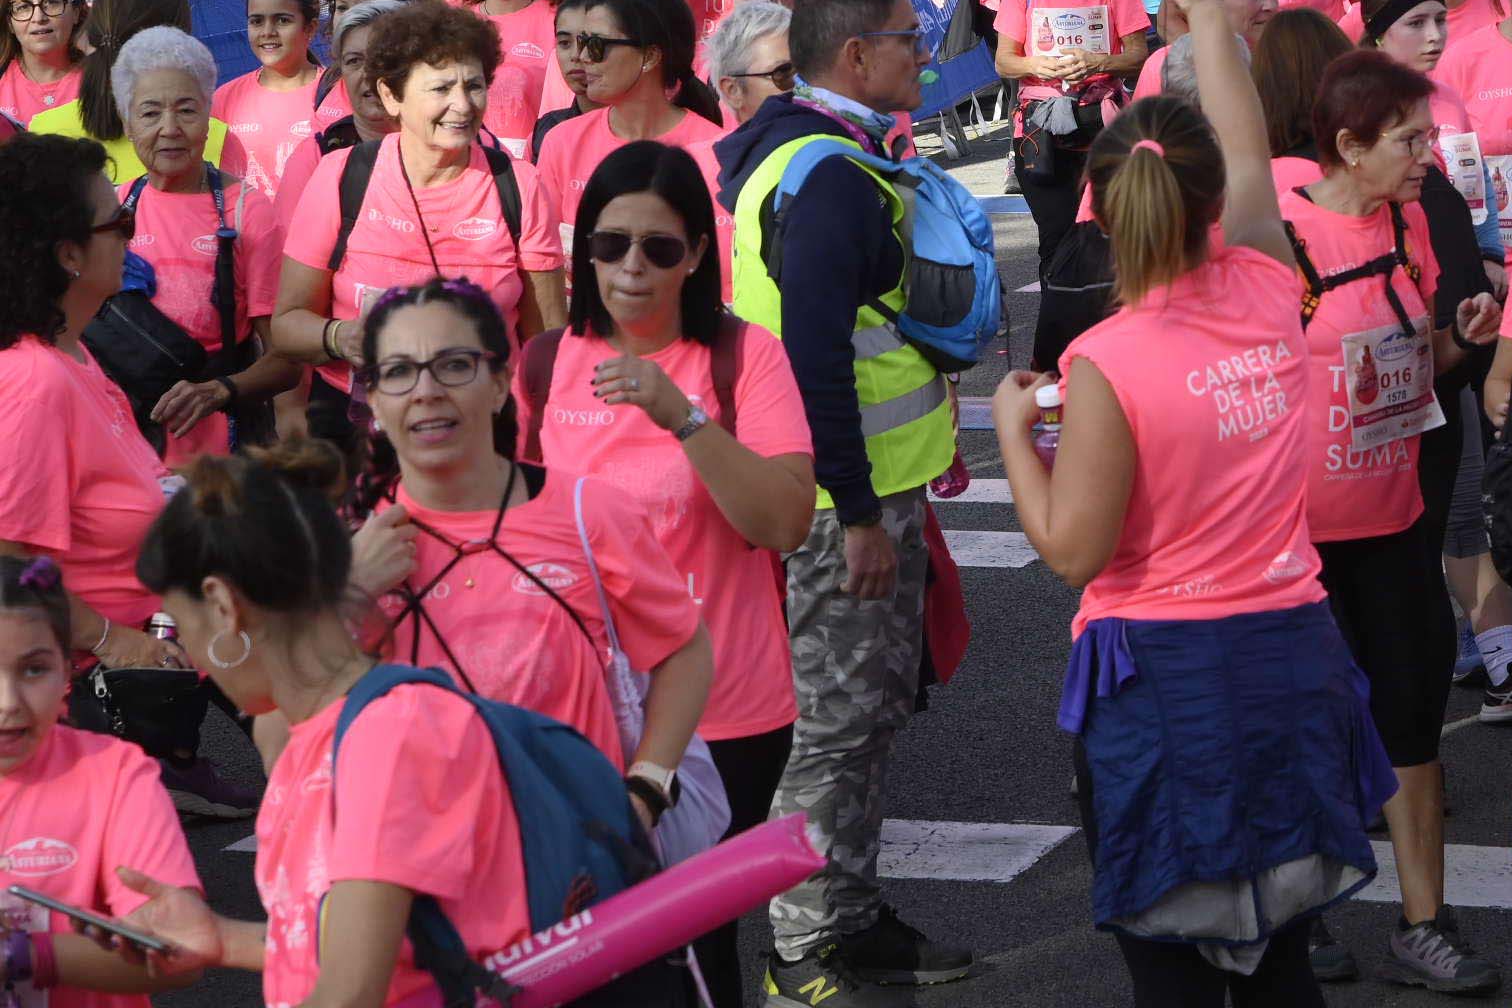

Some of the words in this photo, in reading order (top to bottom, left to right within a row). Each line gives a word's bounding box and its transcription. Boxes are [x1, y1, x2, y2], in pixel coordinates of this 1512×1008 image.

[1056, 34, 1083, 46] 016
[1186, 340, 1292, 397] CARRERA
[1380, 366, 1412, 390] 016
[1213, 380, 1245, 415] DE
[1250, 369, 1281, 401] LA
[554, 410, 615, 426] OYSHO
[1218, 389, 1290, 442] MUJER
[1325, 442, 1409, 472] SUMA
